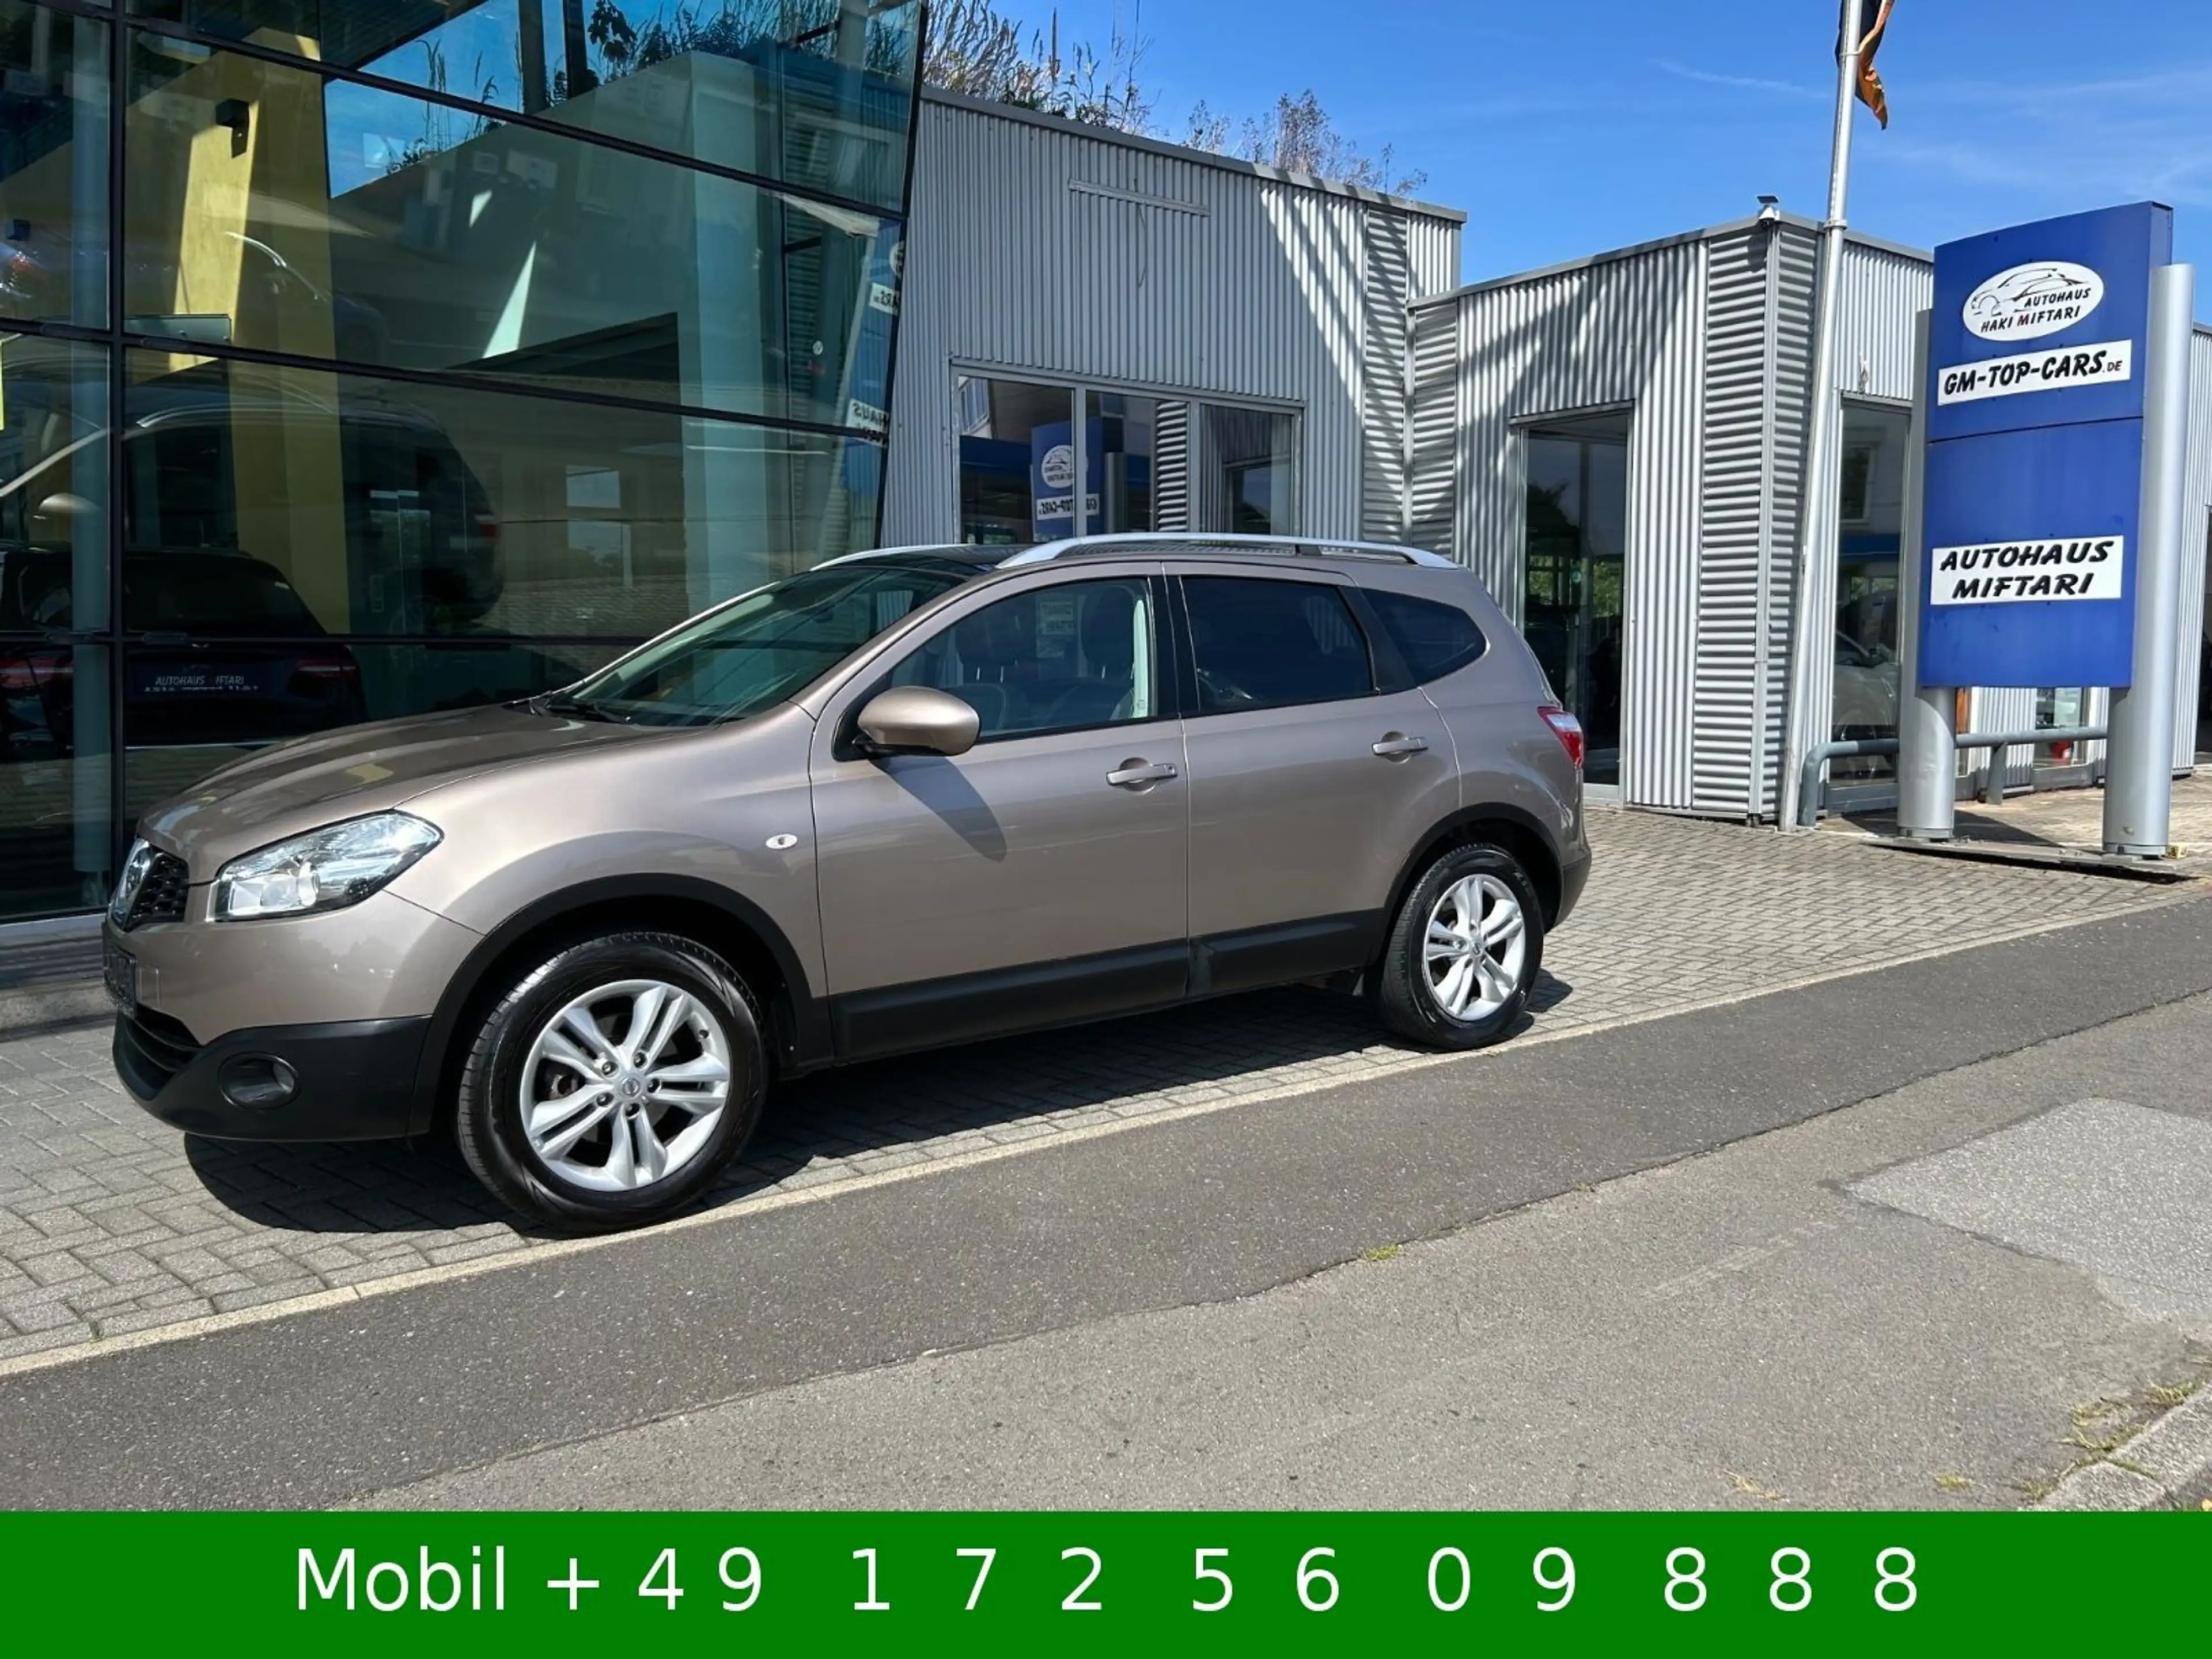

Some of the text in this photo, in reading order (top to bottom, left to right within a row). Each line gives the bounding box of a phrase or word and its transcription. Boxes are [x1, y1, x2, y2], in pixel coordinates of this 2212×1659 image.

[2024, 287, 2091, 308] AUTOHAUS
[1980, 305, 2081, 332] HAKI MIFTARI
[1939, 540, 2115, 571] AUTOHAUS
[1952, 572, 2094, 599] MIFTARI
[154, 675, 245, 685] AUTOHAUS IFTARI
